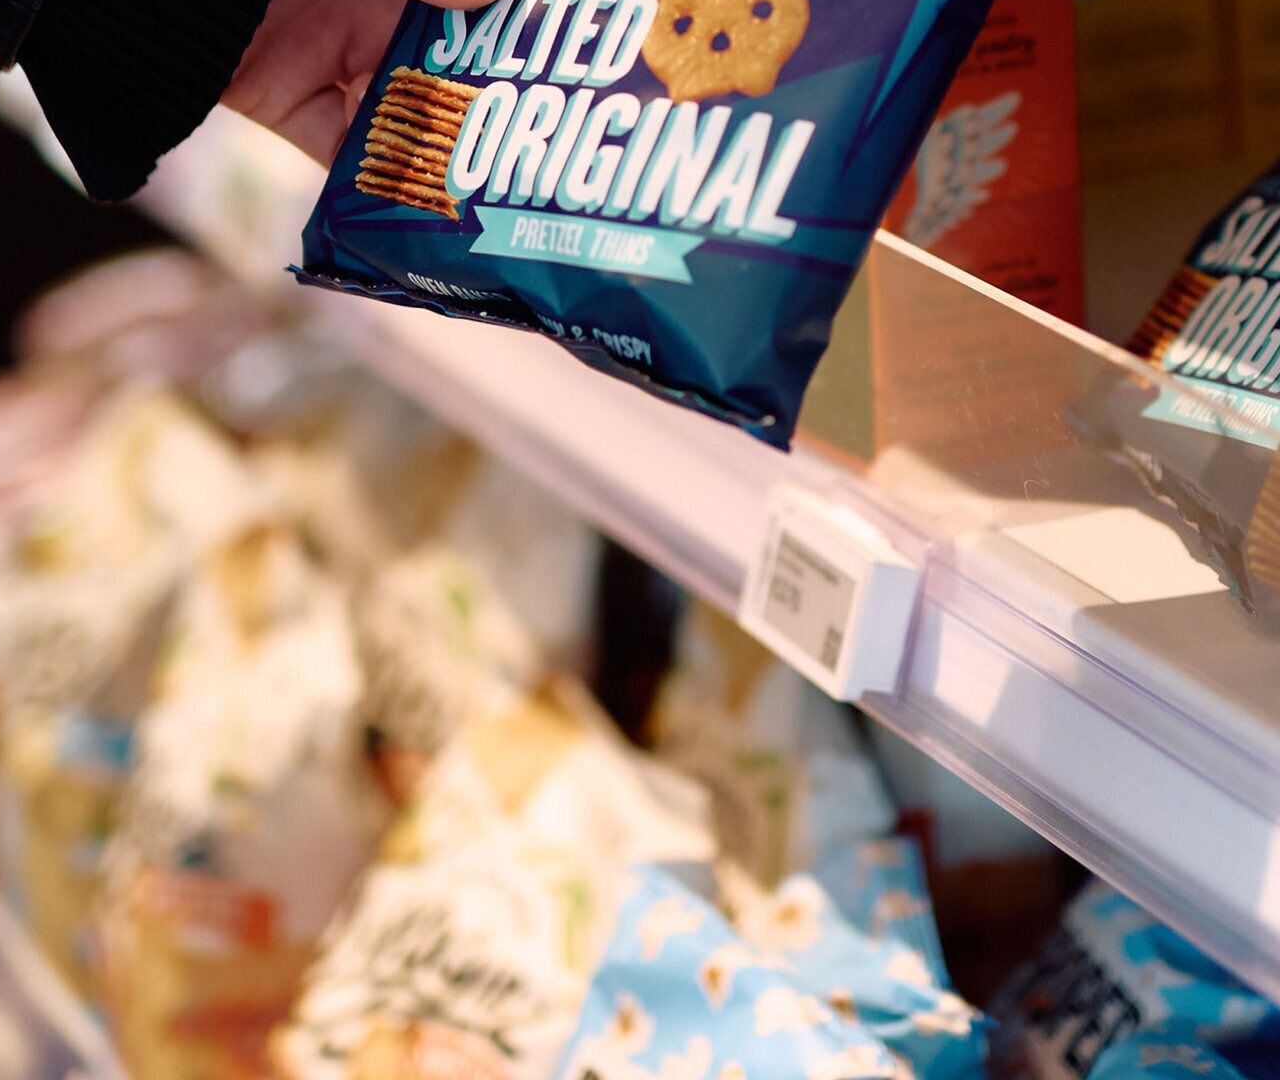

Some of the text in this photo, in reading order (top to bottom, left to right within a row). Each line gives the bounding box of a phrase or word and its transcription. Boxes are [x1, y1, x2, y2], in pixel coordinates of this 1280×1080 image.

[446, 81, 816, 243] ORIGINAL
[510, 216, 656, 266] PRETZEL THINS
[407, 272, 454, 298] OVEN
